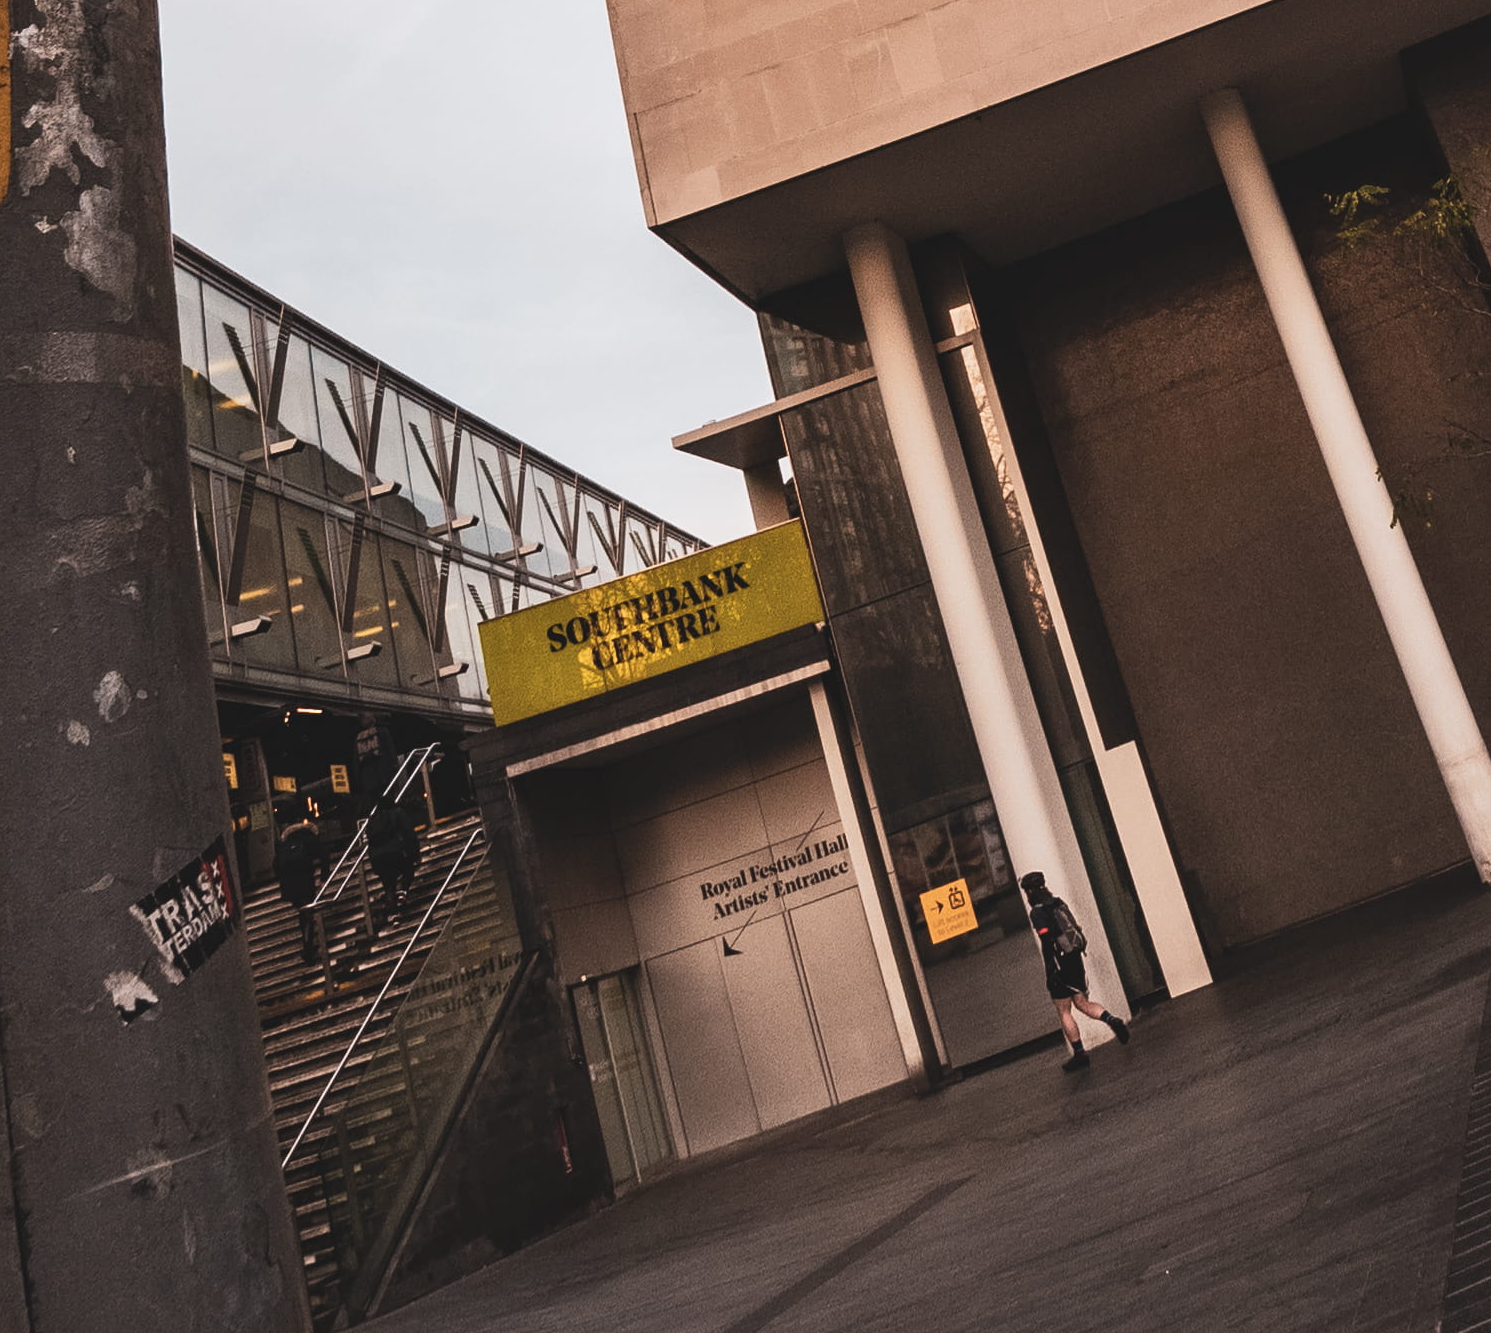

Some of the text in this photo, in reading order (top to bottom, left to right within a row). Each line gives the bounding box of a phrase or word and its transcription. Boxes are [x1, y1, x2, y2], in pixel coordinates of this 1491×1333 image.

[546, 561, 751, 654] SOUTHBANK
[590, 605, 721, 672] CENTRE
[700, 832, 849, 900] Royal Festival Hall
[713, 860, 849, 921] Artists' Entrance
